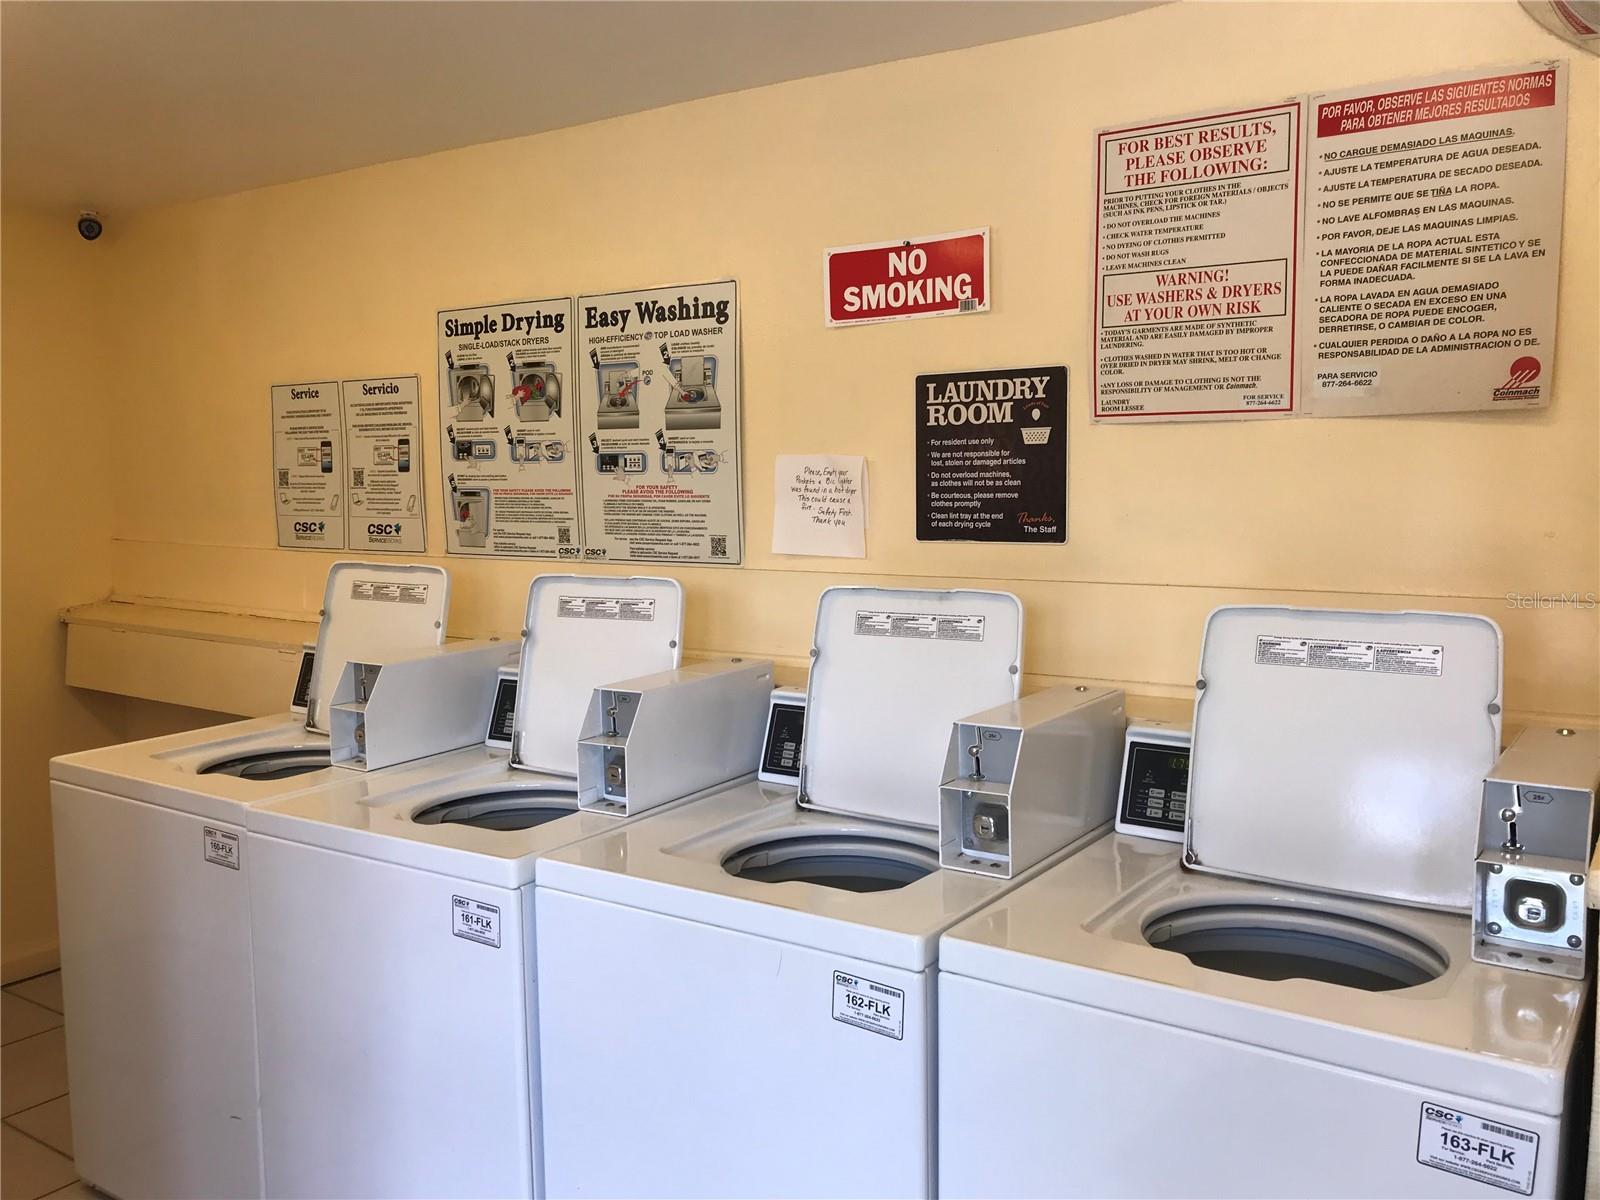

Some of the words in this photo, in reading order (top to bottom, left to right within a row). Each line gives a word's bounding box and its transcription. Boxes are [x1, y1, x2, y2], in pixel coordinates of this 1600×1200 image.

[1322, 105, 1342, 118] POR
[1343, 100, 1375, 115] FAVOR,
[1378, 92, 1423, 110] OBSERVE
[1424, 89, 1445, 103] LAS
[1445, 81, 1507, 100] SIGUIENTES
[1506, 74, 1552, 92] NORMAS
[1340, 117, 1364, 131] PARA
[1368, 110, 1413, 127] OBTENER
[1414, 102, 1463, 120] MEJORES
[1462, 94, 1530, 113] RESULTADOS
[1118, 140, 1149, 155] FOR
[1154, 133, 1194, 150] BEST
[1199, 121, 1275, 143] RESULTS,
[1324, 152, 1338, 160] NO
[1339, 146, 1379, 158] CARGUE
[1379, 138, 1438, 152] DEMASIADO
[1437, 135, 1459, 146] LAS
[1459, 128, 1515, 143] MAQUINAS.
[1126, 151, 1185, 170] PLEASE
[1190, 140, 1267, 161] OBSERVE
[1124, 172, 1156, 187] THE
[1161, 159, 1267, 182] FOLLOWING:
[1132, 218, 1168, 226] OVERLOAD
[1185, 212, 1220, 220] MACHINES
[1337, 214, 1360, 223] LAVE
[1362, 208, 1420, 220] ALFOMBRAS
[1423, 206, 1436, 214] EN
[1438, 203, 1457, 212] LAS
[1460, 198, 1514, 209] MAQUINAS.
[1154, 224, 1204, 234] TEMPERATURE
[889, 249, 927, 278] NO
[1128, 260, 1162, 268] MACHINES
[1156, 270, 1228, 286] WARNING!
[843, 273, 972, 312] SMOKING
[1108, 294, 1132, 307] USE
[1136, 288, 1202, 304] WASHERS
[1207, 287, 1217, 300] &
[1222, 282, 1281, 298] DRYERS
[585, 307, 630, 332] Easy
[635, 296, 729, 324] Washing
[1124, 309, 1141, 322] AT
[1145, 306, 1183, 320] YOUR
[1188, 304, 1222, 317] OWN
[1226, 301, 1261, 314] RISK
[445, 315, 497, 340] Simple
[502, 310, 564, 335] Drying
[589, 333, 643, 344] HIGH-EFFICIENCY
[692, 327, 723, 335] WASHER
[459, 339, 520, 351] SINGLE-LOAD/STACK
[522, 337, 549, 345] DRYERS
[291, 388, 319, 400] Service
[363, 383, 399, 395] Servicio
[926, 376, 1050, 404] LAUNDRY
[1493, 387, 1540, 396] Coinmach
[926, 402, 1013, 426] ROOM
[294, 522, 316, 532] CSC
[368, 524, 392, 534] CSC
[812, 516, 831, 525] Thank
[461, 913, 492, 929] 161-FLK
[836, 975, 853, 984] CSC
[845, 994, 891, 1016] 162-FLK
[1425, 1107, 1454, 1121] CSC
[1441, 1132, 1515, 1166] 163-FLK
